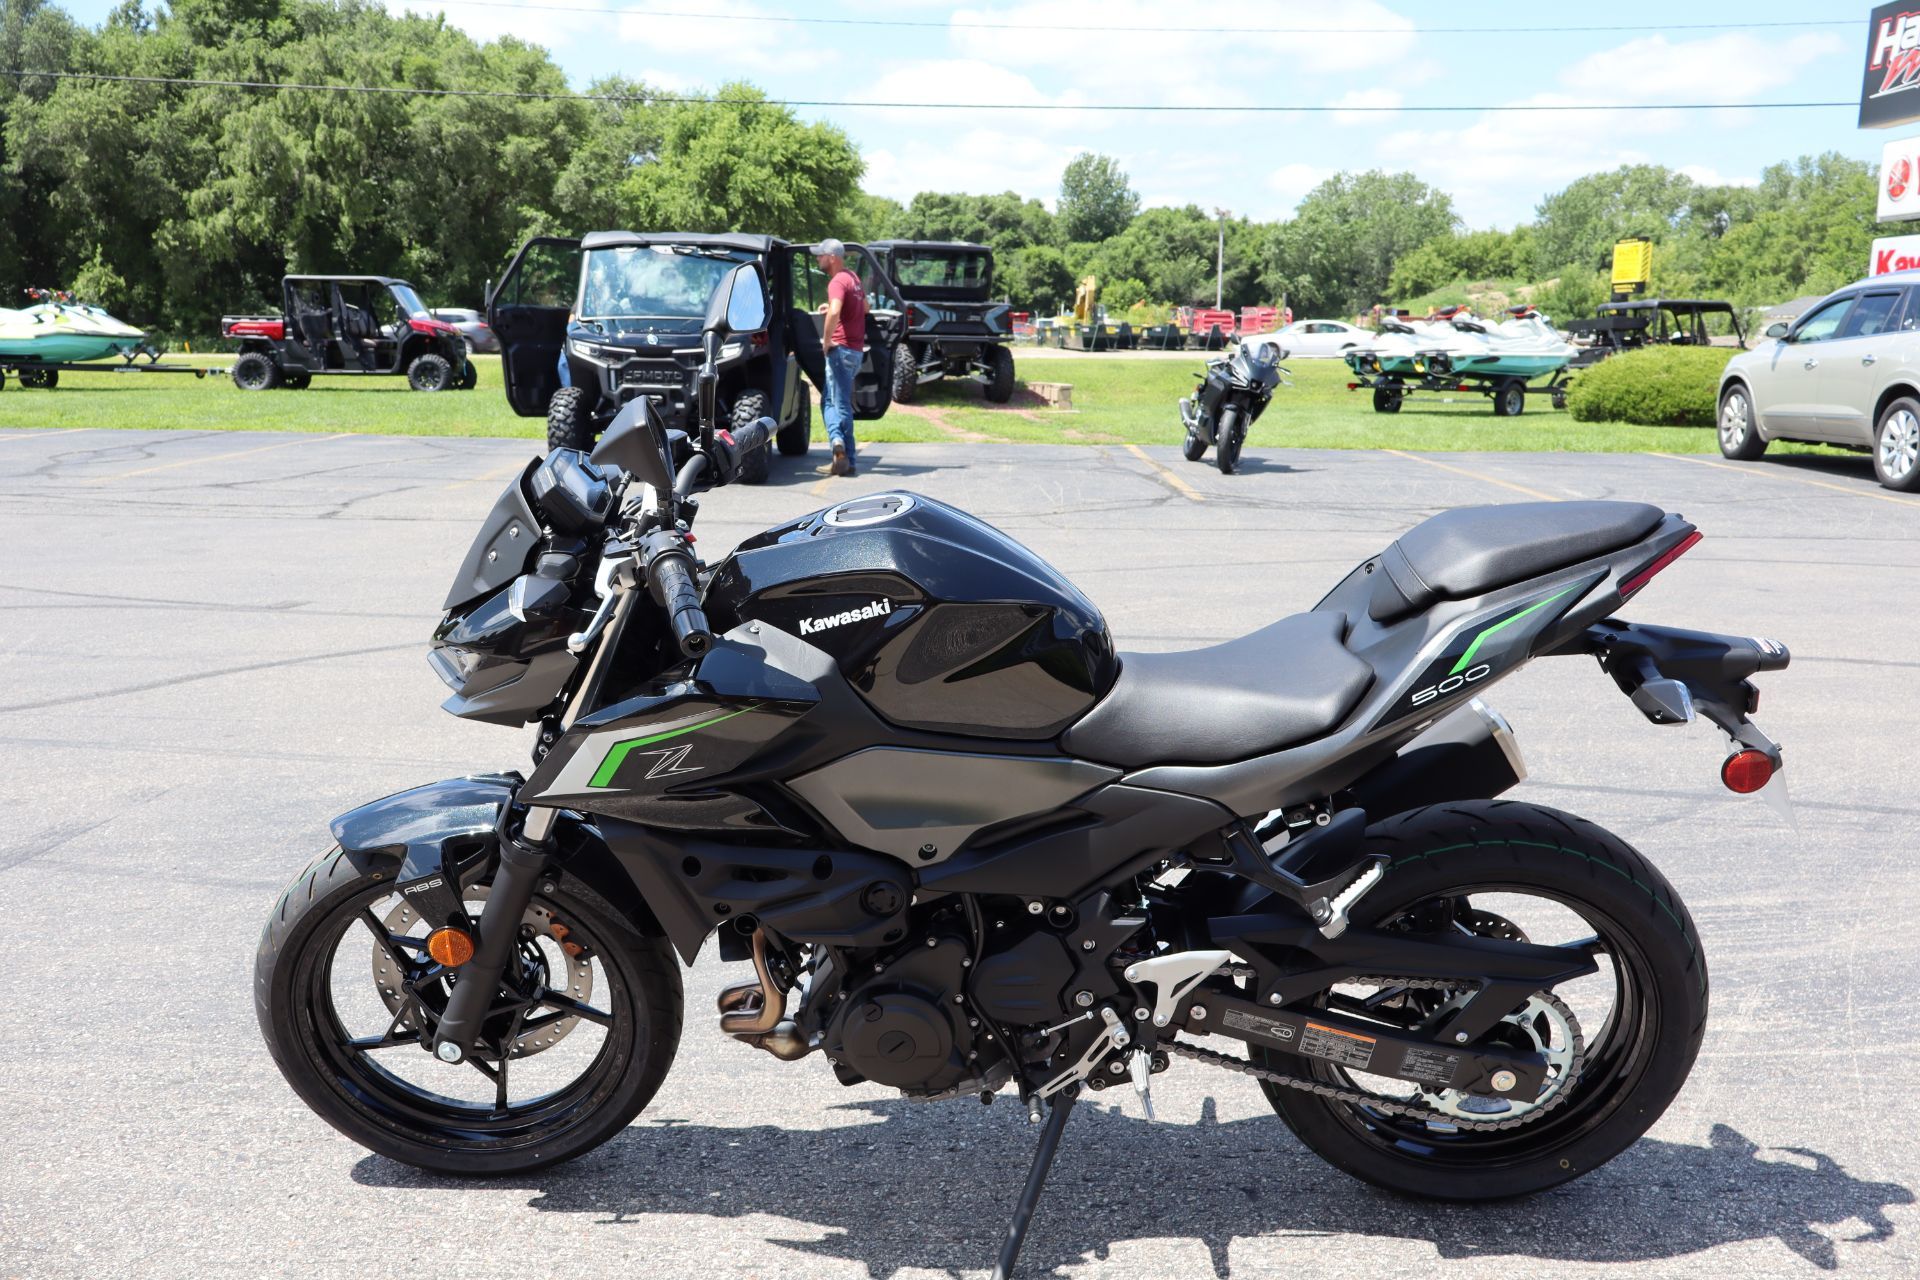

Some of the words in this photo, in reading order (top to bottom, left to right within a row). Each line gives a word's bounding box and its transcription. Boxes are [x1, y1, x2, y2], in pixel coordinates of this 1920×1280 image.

[623, 369, 684, 381] CFMOTO
[799, 598, 891, 635] Kawasaki
[1411, 664, 1491, 706] 500
[639, 743, 705, 780] Z
[404, 878, 443, 896] ABS
